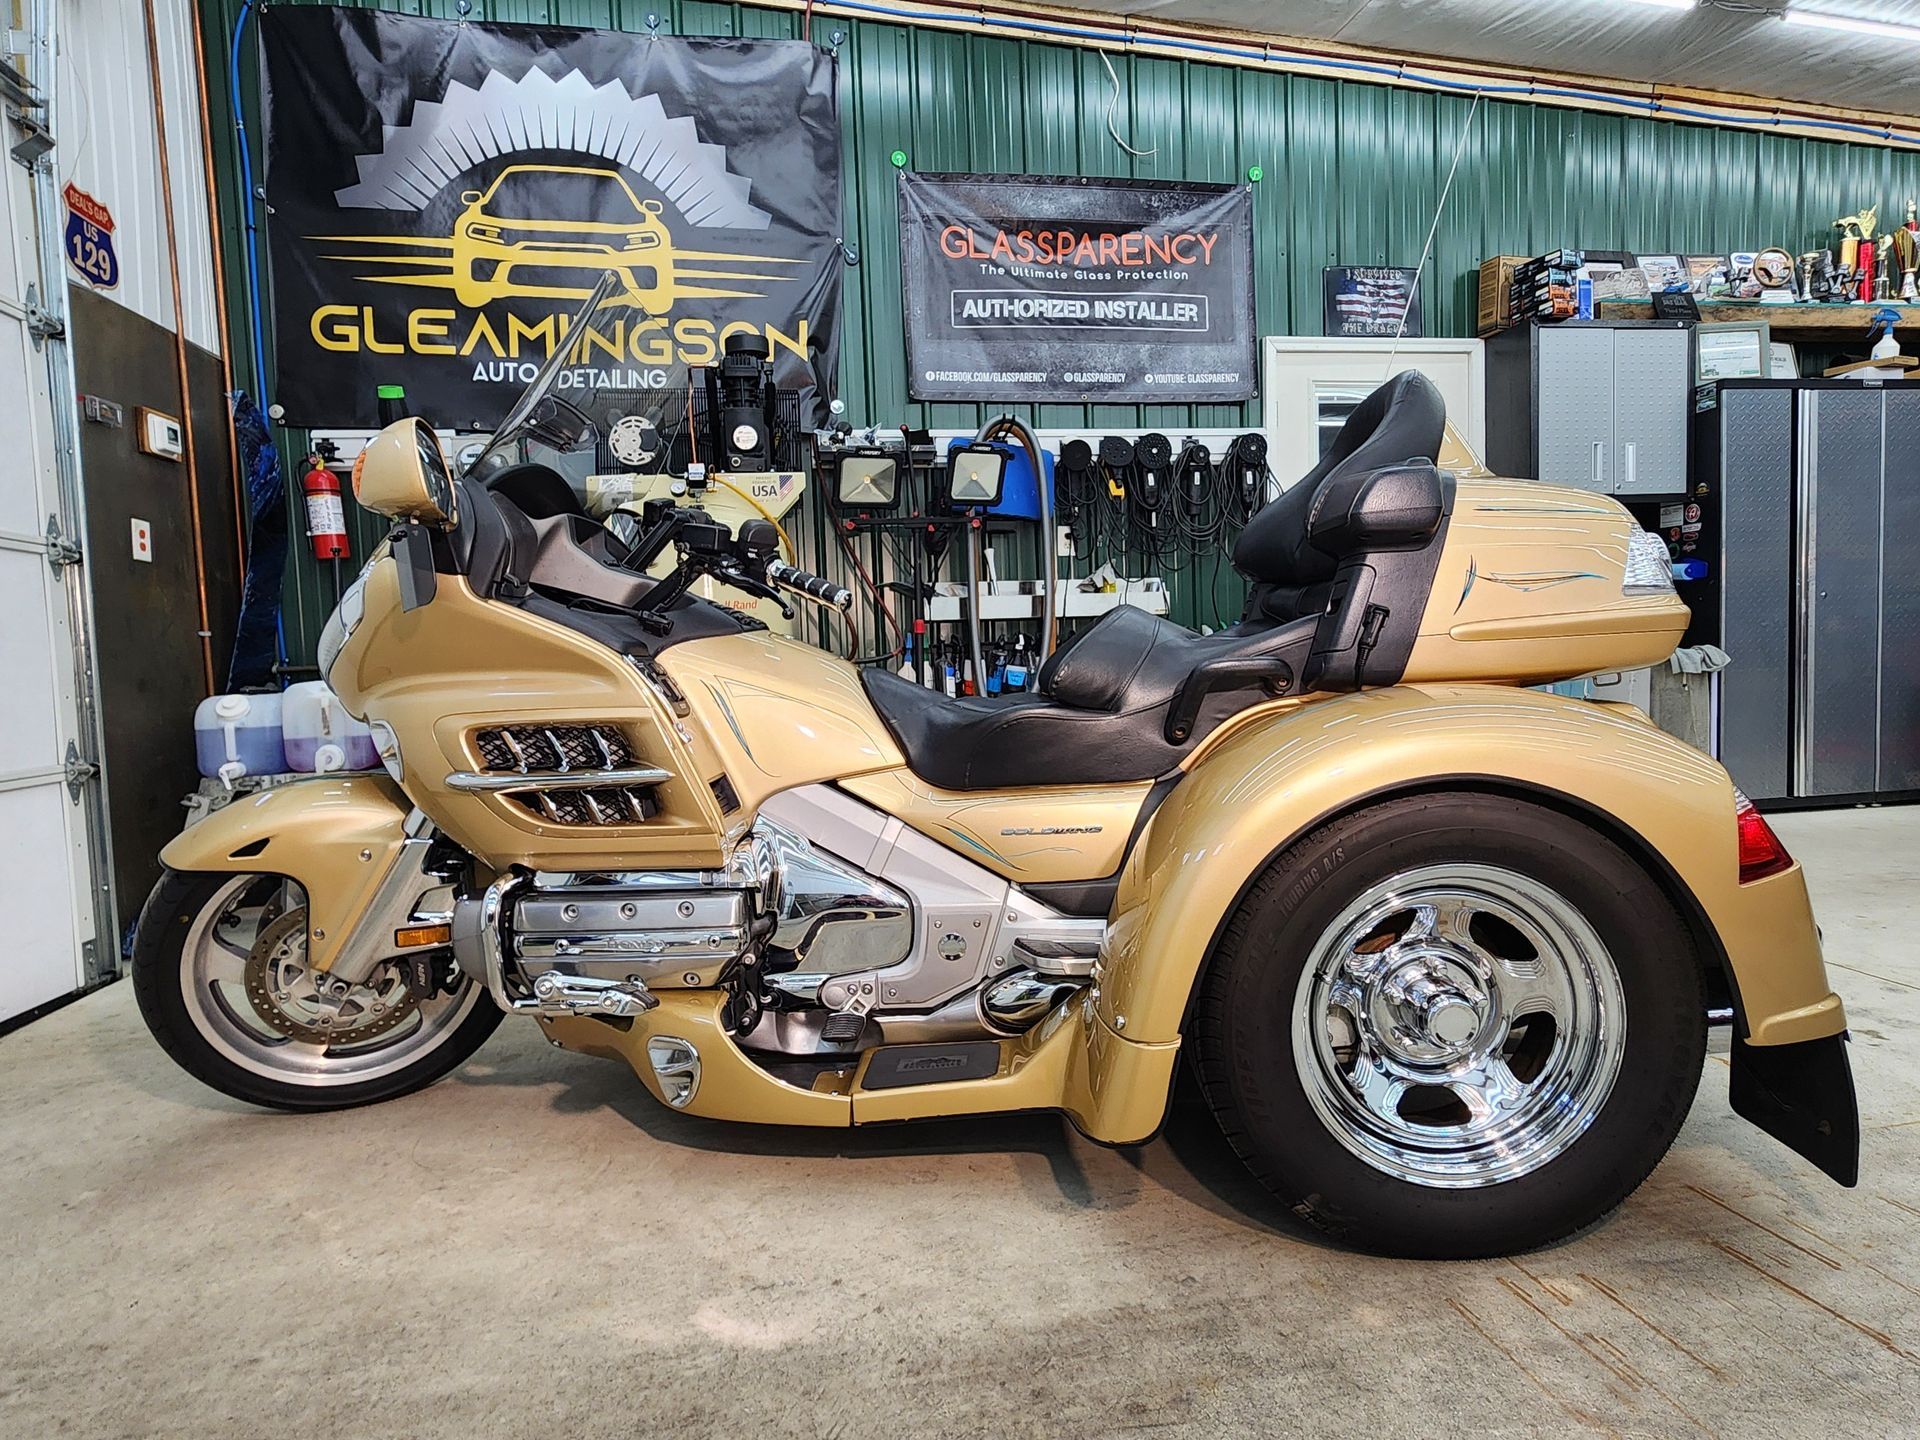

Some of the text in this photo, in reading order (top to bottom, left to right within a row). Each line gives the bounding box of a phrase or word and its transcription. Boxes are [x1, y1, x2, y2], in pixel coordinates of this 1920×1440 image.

[69, 189, 109, 224] DEAL'S GAP
[83, 220, 99, 242] US
[73, 233, 111, 281] 129
[940, 226, 1217, 266] GLASSPARENCY
[980, 264, 1189, 281] The Ultimate Glass Protection
[962, 299, 1199, 322] AUTHORIZED INSTALLER
[1342, 322, 1363, 333] THE
[472, 362, 667, 389] AUTO DETAILING
[936, 371, 1239, 384] FACEBOOK.COM/GLASSPARENCY GLASSPARENCY YOUTUBE: GLASSPARENCY
[752, 485, 778, 497] USA
[733, 600, 758, 610] Rand
[1280, 847, 1345, 918] TOURING A/S
